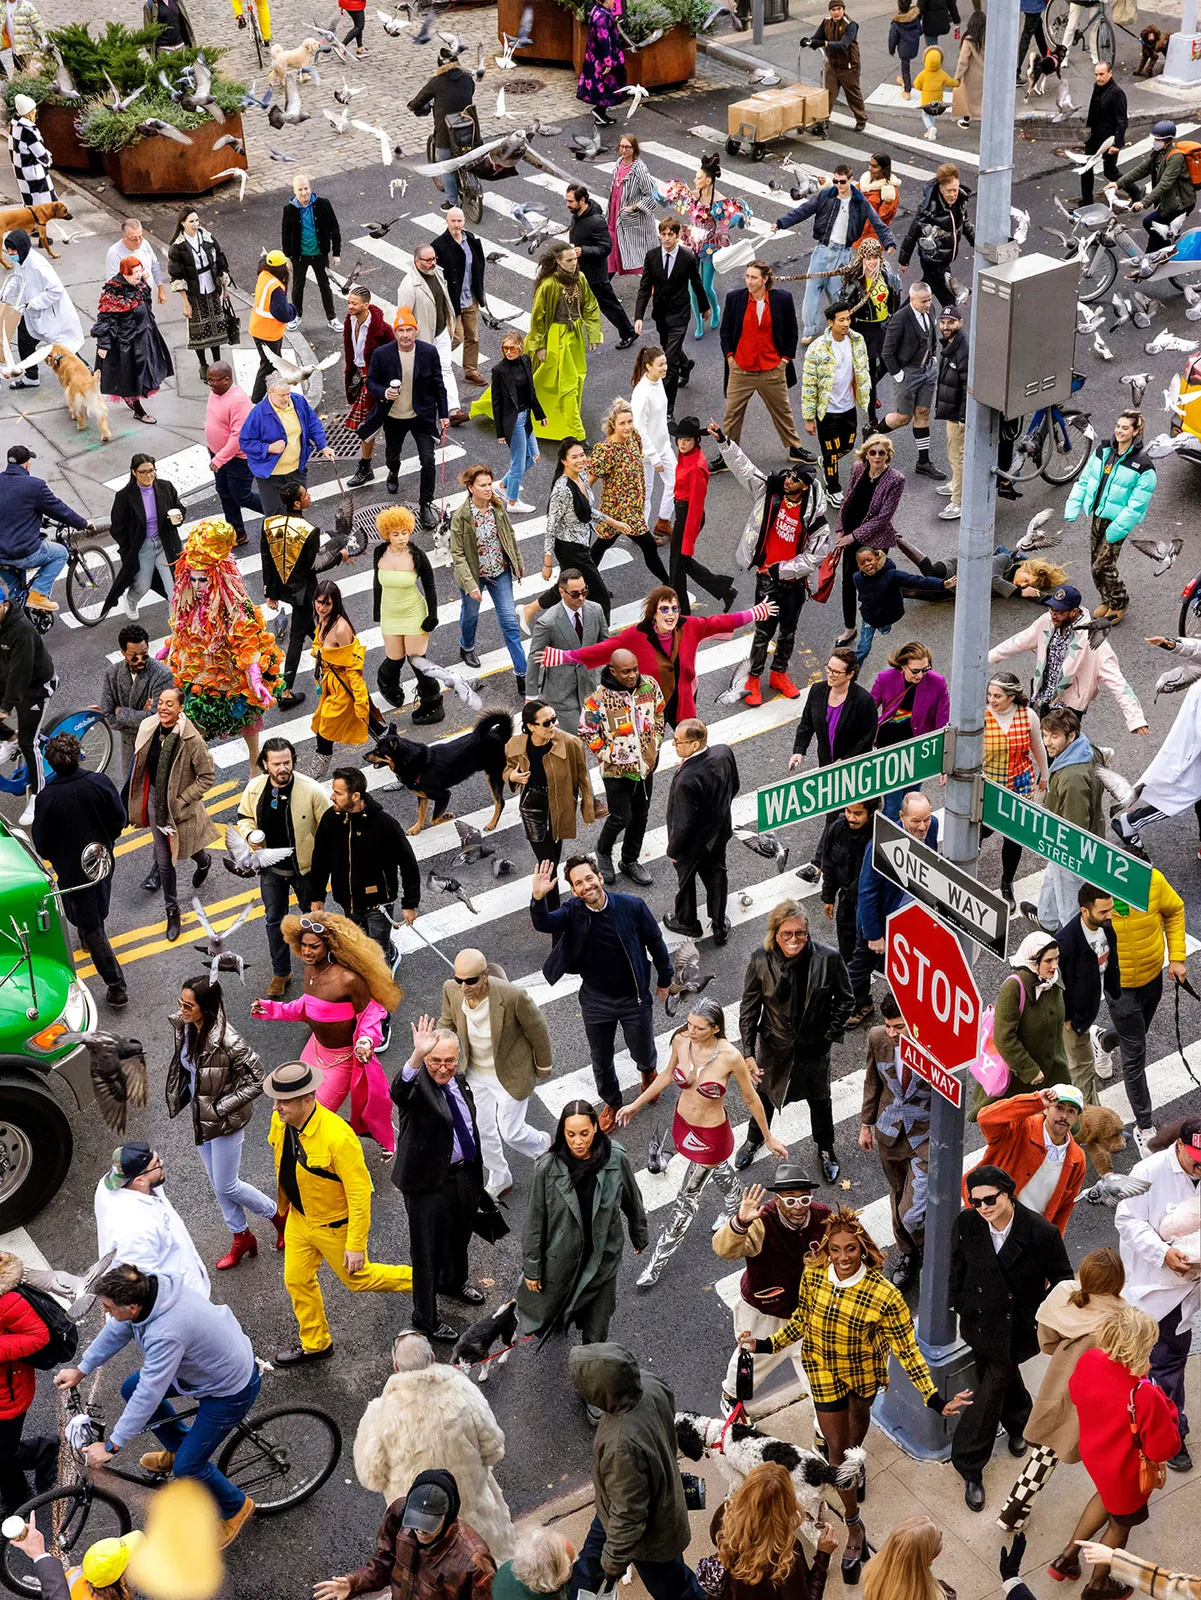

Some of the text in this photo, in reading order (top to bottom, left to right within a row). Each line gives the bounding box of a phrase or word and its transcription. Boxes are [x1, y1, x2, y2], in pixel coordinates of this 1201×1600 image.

[764, 738, 939, 825] WASHINGTON ST
[997, 790, 1130, 883] LITTLE W 12
[1037, 839, 1084, 873] STREET
[893, 845, 989, 928] ONE WAY
[891, 933, 975, 1037] STOP
[904, 1045, 927, 1074] ALL
[930, 1065, 956, 1096] WAY
